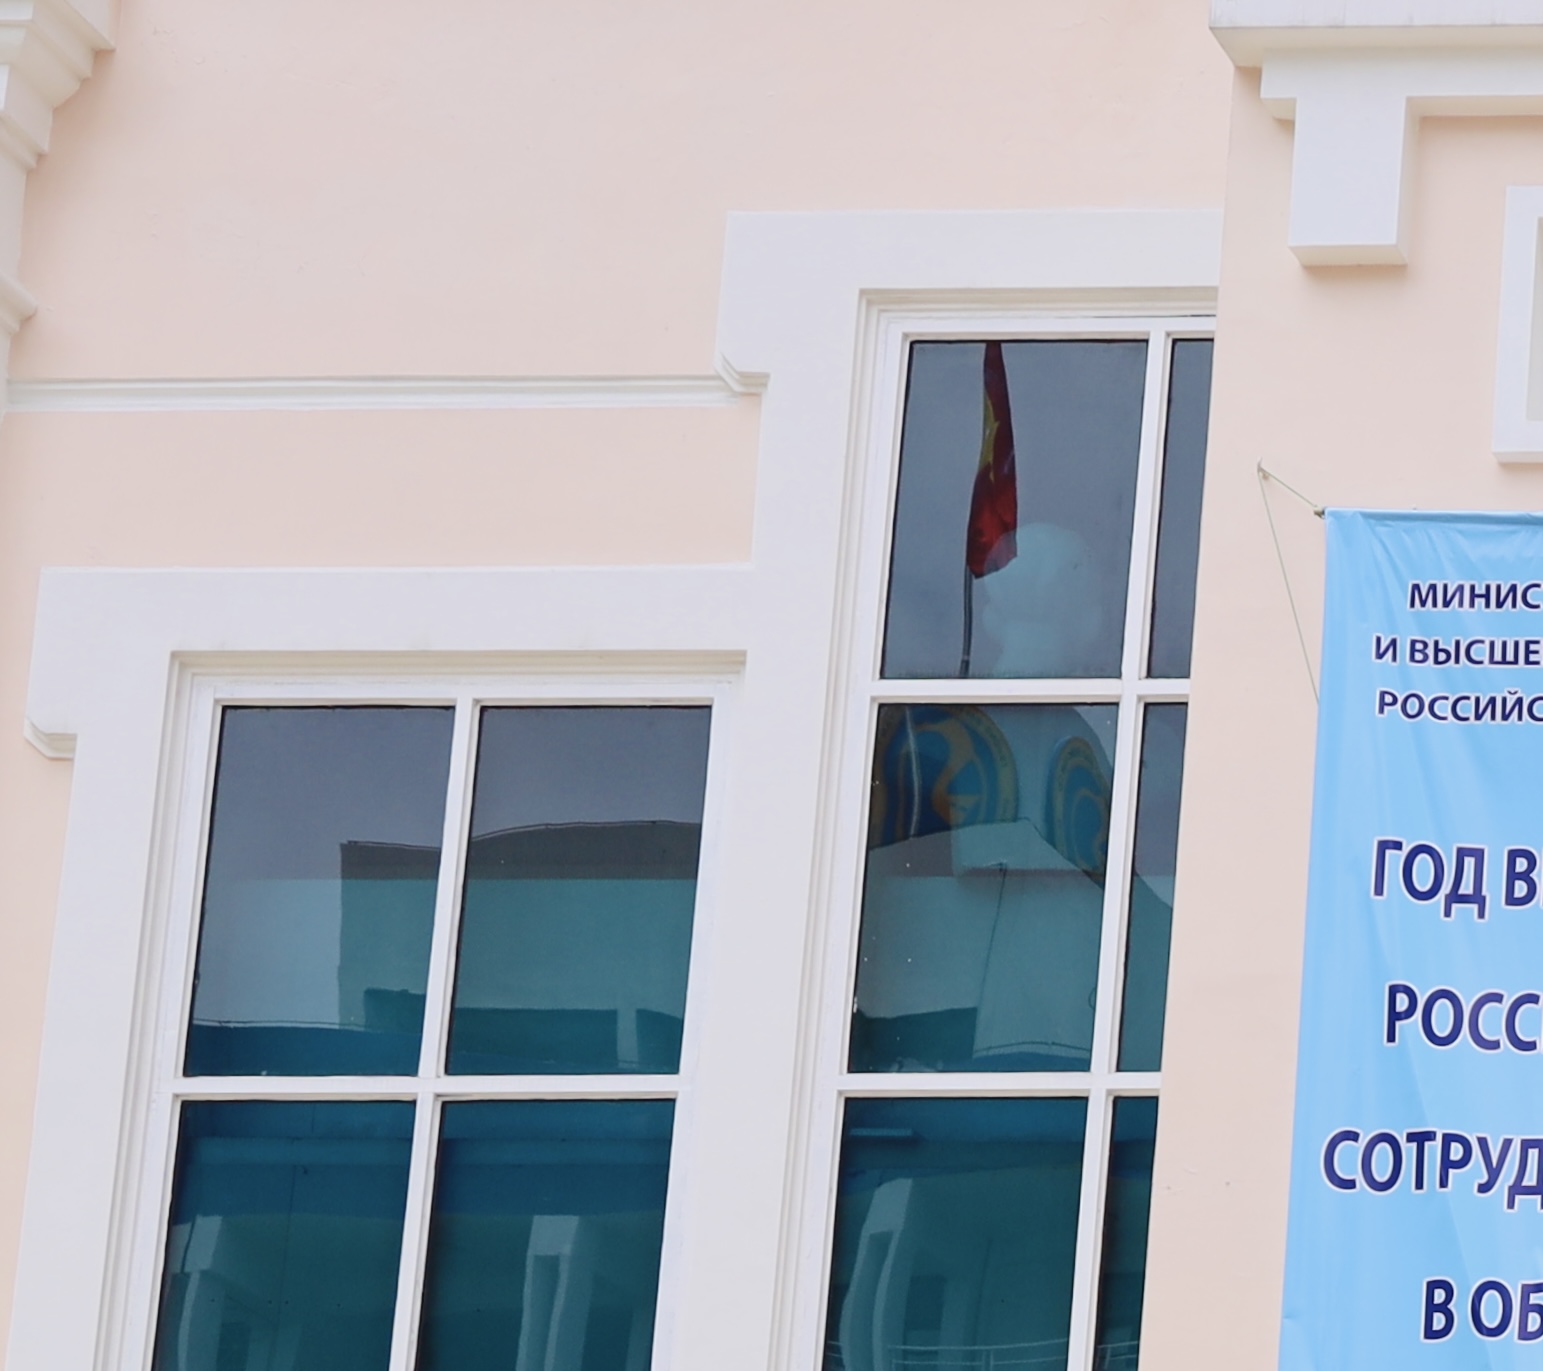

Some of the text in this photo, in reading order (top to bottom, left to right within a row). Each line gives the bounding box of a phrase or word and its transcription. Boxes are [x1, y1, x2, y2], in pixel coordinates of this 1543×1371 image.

[1374, 634, 1398, 664] И
[1373, 838, 1488, 920] ГОД
[1422, 1278, 1456, 1341] В
